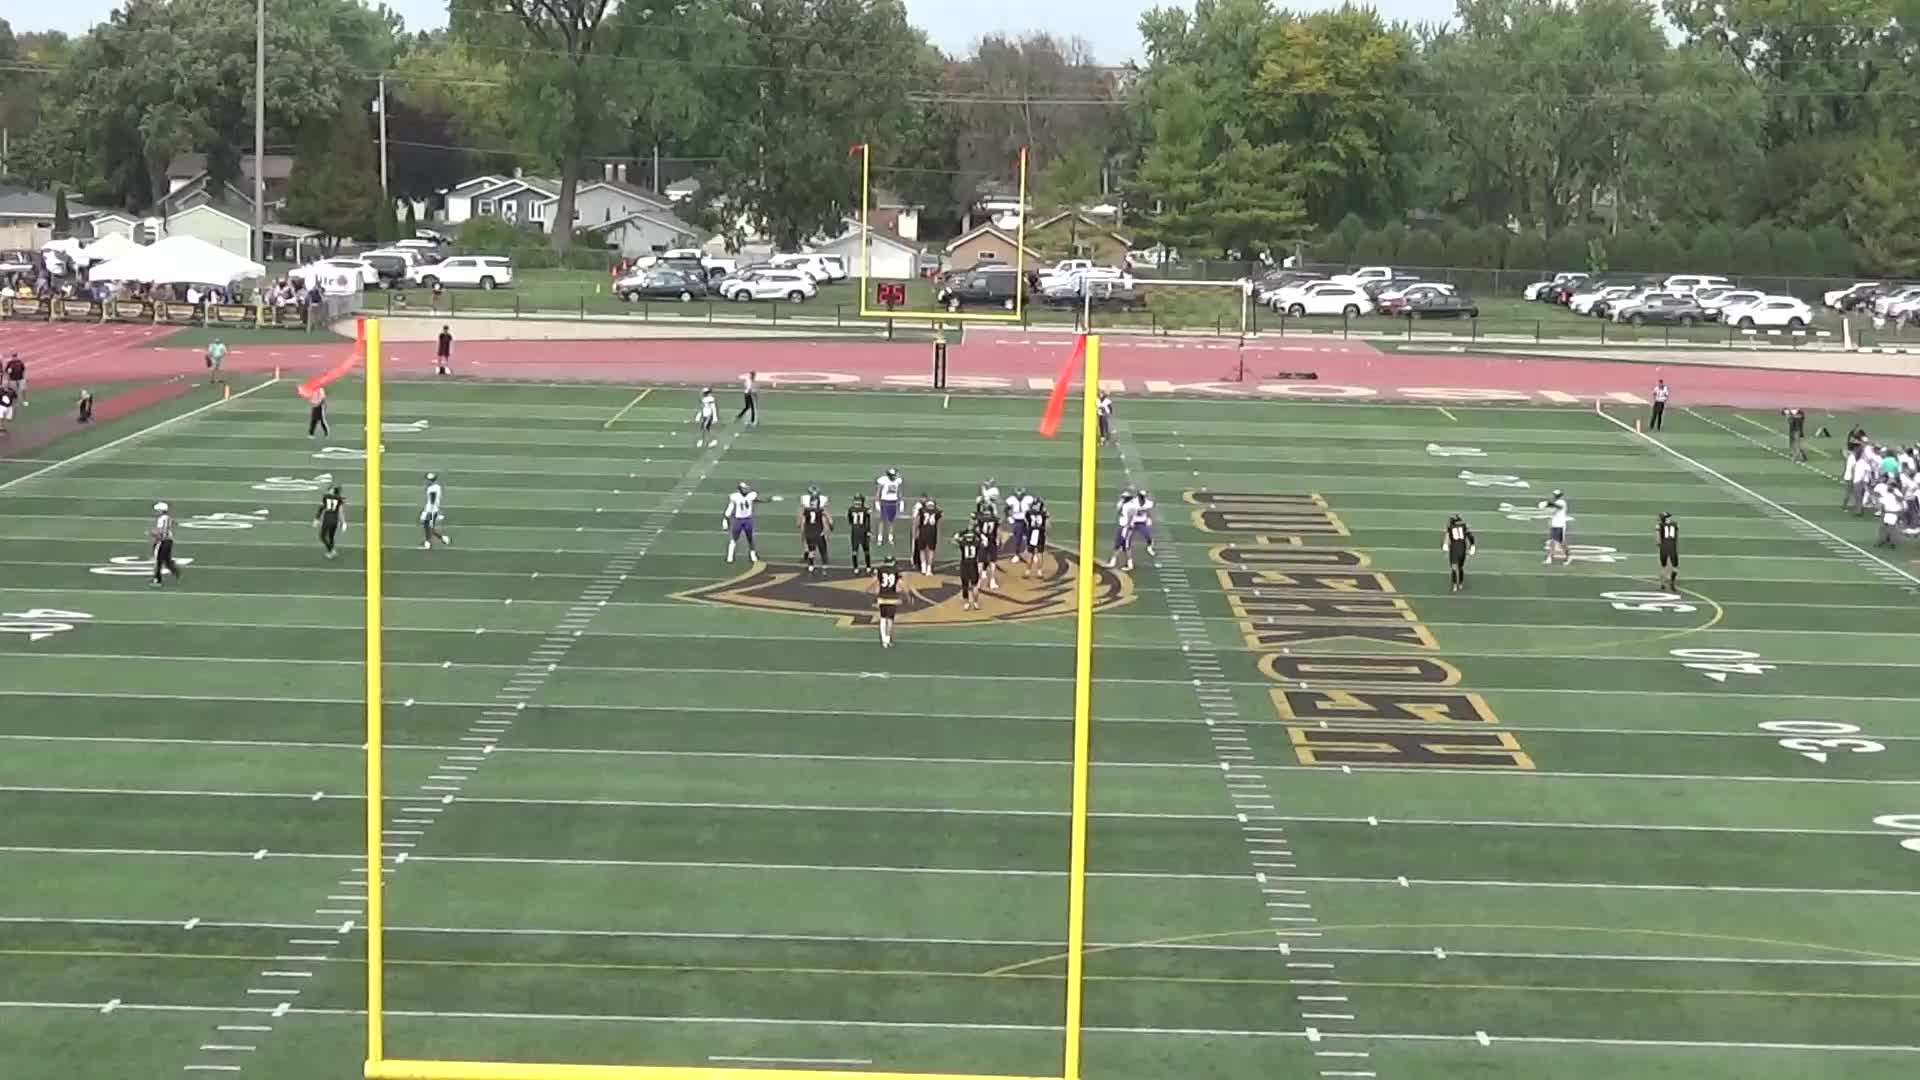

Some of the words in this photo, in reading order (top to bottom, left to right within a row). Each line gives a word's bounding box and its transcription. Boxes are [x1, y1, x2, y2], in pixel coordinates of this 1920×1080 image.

[879, 284, 903, 305] 25
[881, 572, 896, 588] 39
[1600, 591, 1698, 613] 50
[1669, 648, 1777, 675] 40
[1757, 720, 1886, 753] 30
